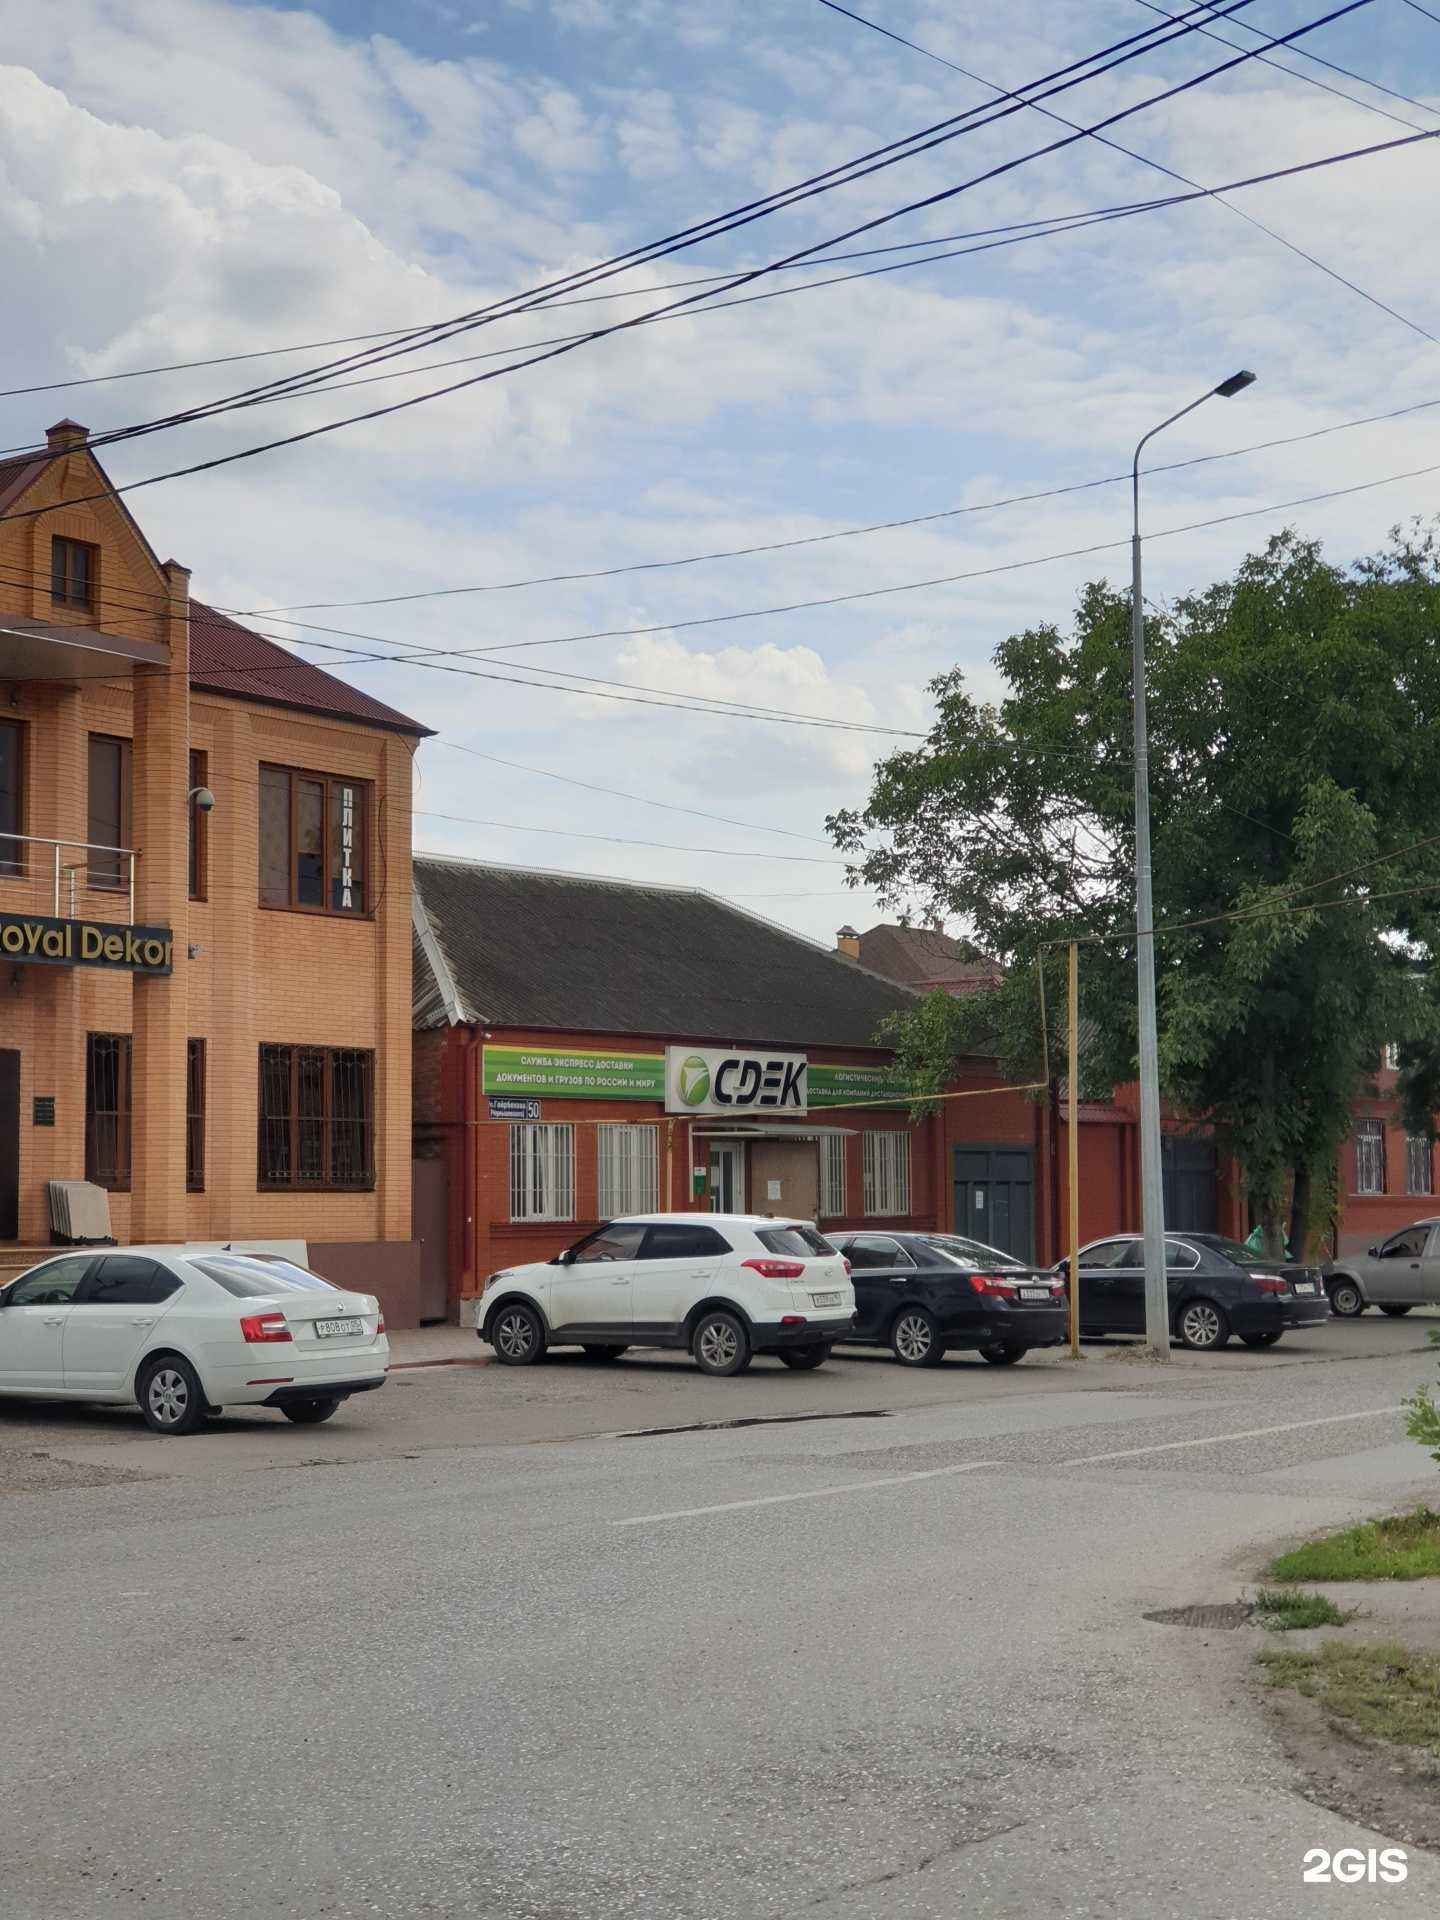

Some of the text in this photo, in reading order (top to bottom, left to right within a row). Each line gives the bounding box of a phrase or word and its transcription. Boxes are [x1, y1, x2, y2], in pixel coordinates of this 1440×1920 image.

[342, 788, 353, 908] ПЛИТКА
[0, 922, 72, 958] oyal
[520, 1056, 634, 1070] СЛУЖБА ЭКСПРЕСС ДОСТАВКИ
[496, 1072, 547, 1083] ДОКУМЕНТОВ
[555, 1075, 584, 1085] ГРУЗОВ
[584, 1076, 596, 1086] ПО
[597, 1077, 628, 1088] РОССИИ
[636, 1080, 656, 1088] МИРУ
[715, 1059, 807, 1106] CDEK
[528, 1102, 540, 1118] 50
